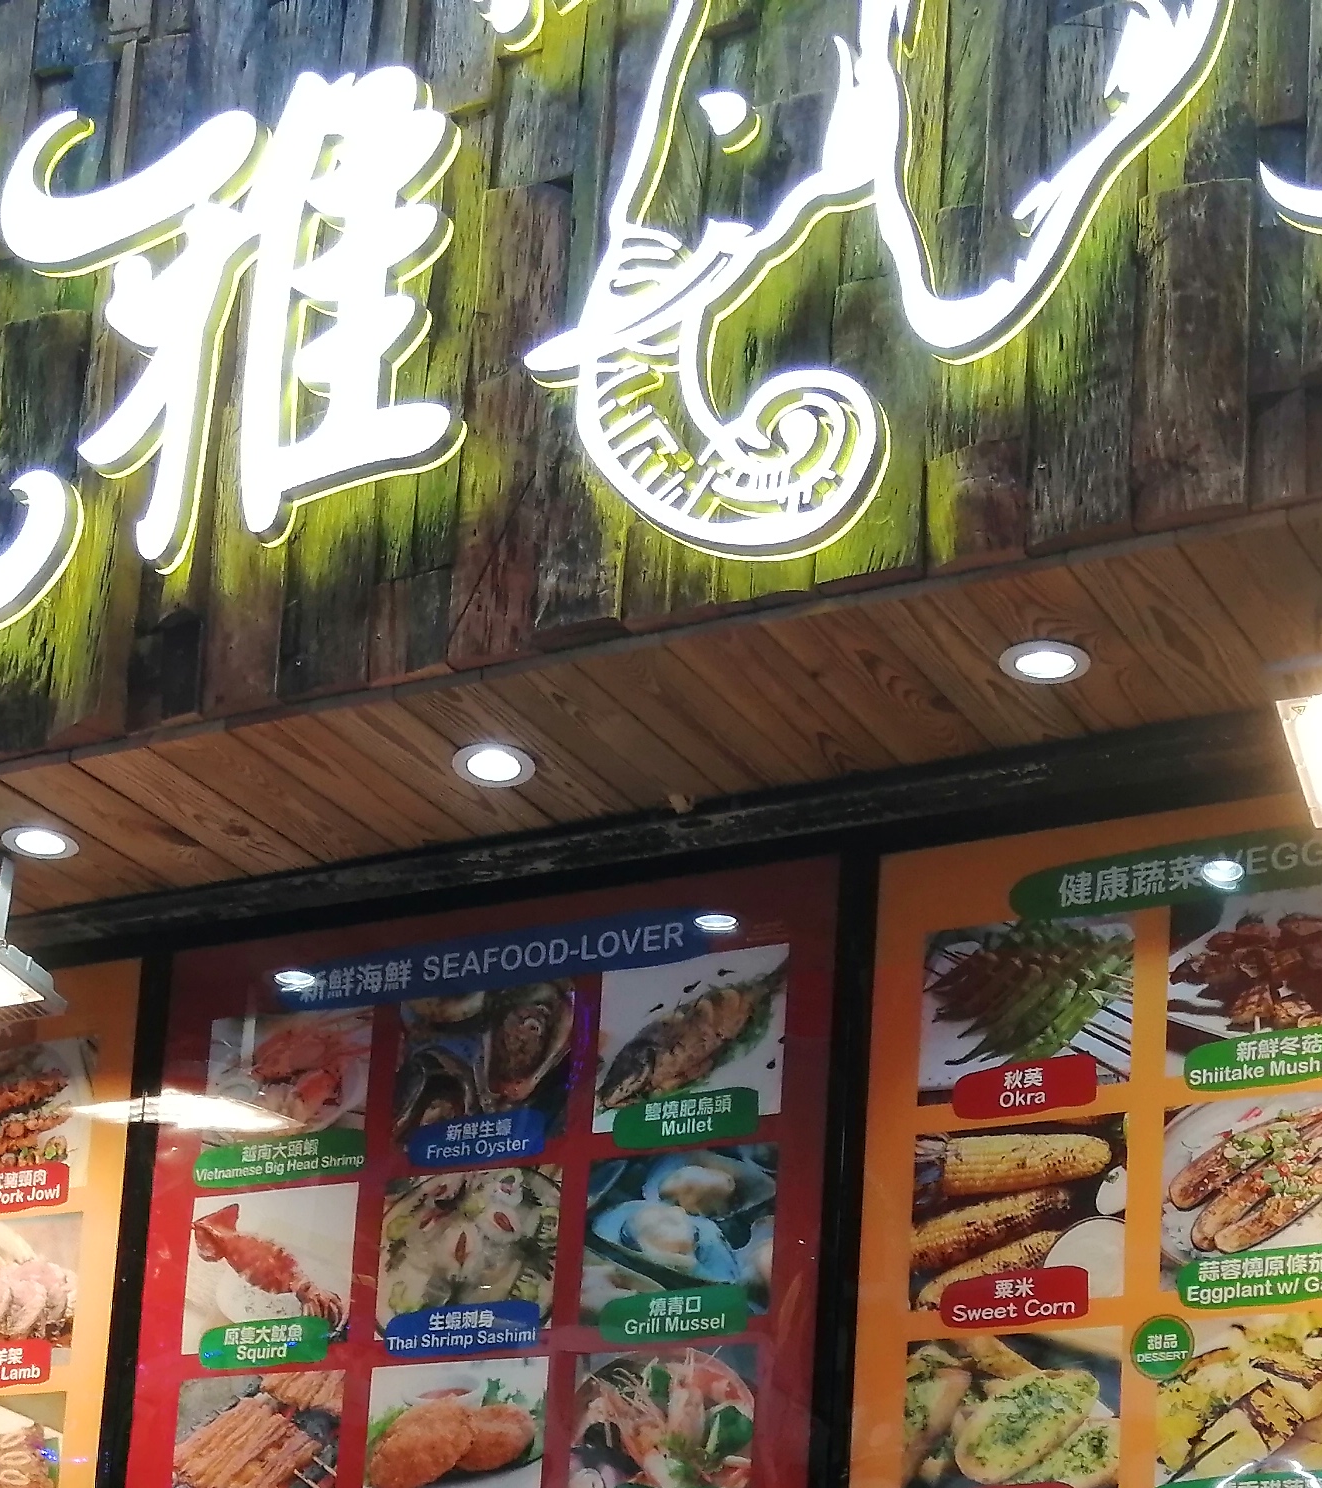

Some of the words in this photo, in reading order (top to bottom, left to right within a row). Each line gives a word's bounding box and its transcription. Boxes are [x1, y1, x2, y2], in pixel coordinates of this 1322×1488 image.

[1058, 855, 1205, 907] 健康蔬菜
[423, 921, 685, 982] SEAFOOD-LOVER
[1003, 1067, 1043, 1090] 秋葵
[1189, 1064, 1265, 1087] Shiitake
[999, 1088, 1046, 1108] Okra
[662, 1116, 713, 1137] Mullet
[427, 1141, 473, 1160] Fresh
[474, 1137, 530, 1158] Oyster
[195, 1164, 264, 1182] Vietnamese
[265, 1161, 286, 1177] Big
[286, 1156, 320, 1172] Head
[321, 1153, 365, 1170] Shrimp
[27, 1184, 61, 1202] Jowl
[1186, 1282, 1271, 1307] Eggplant
[1277, 1277, 1299, 1295] w/
[649, 1295, 702, 1317] 燒青口
[951, 1300, 1018, 1324] Sweet
[1022, 1298, 1076, 1318] Corn
[428, 1309, 495, 1331] 生蝦刺身
[624, 1317, 660, 1335] Grill
[665, 1312, 726, 1333] Mussel
[387, 1335, 419, 1351] Thai
[421, 1331, 474, 1350] Shrimp
[476, 1327, 536, 1345] Sashimi
[1147, 1334, 1178, 1350] 甜品
[236, 1343, 287, 1362] Squird
[1136, 1349, 1189, 1364] DESSERT
[1, 1364, 41, 1381] Lamb
